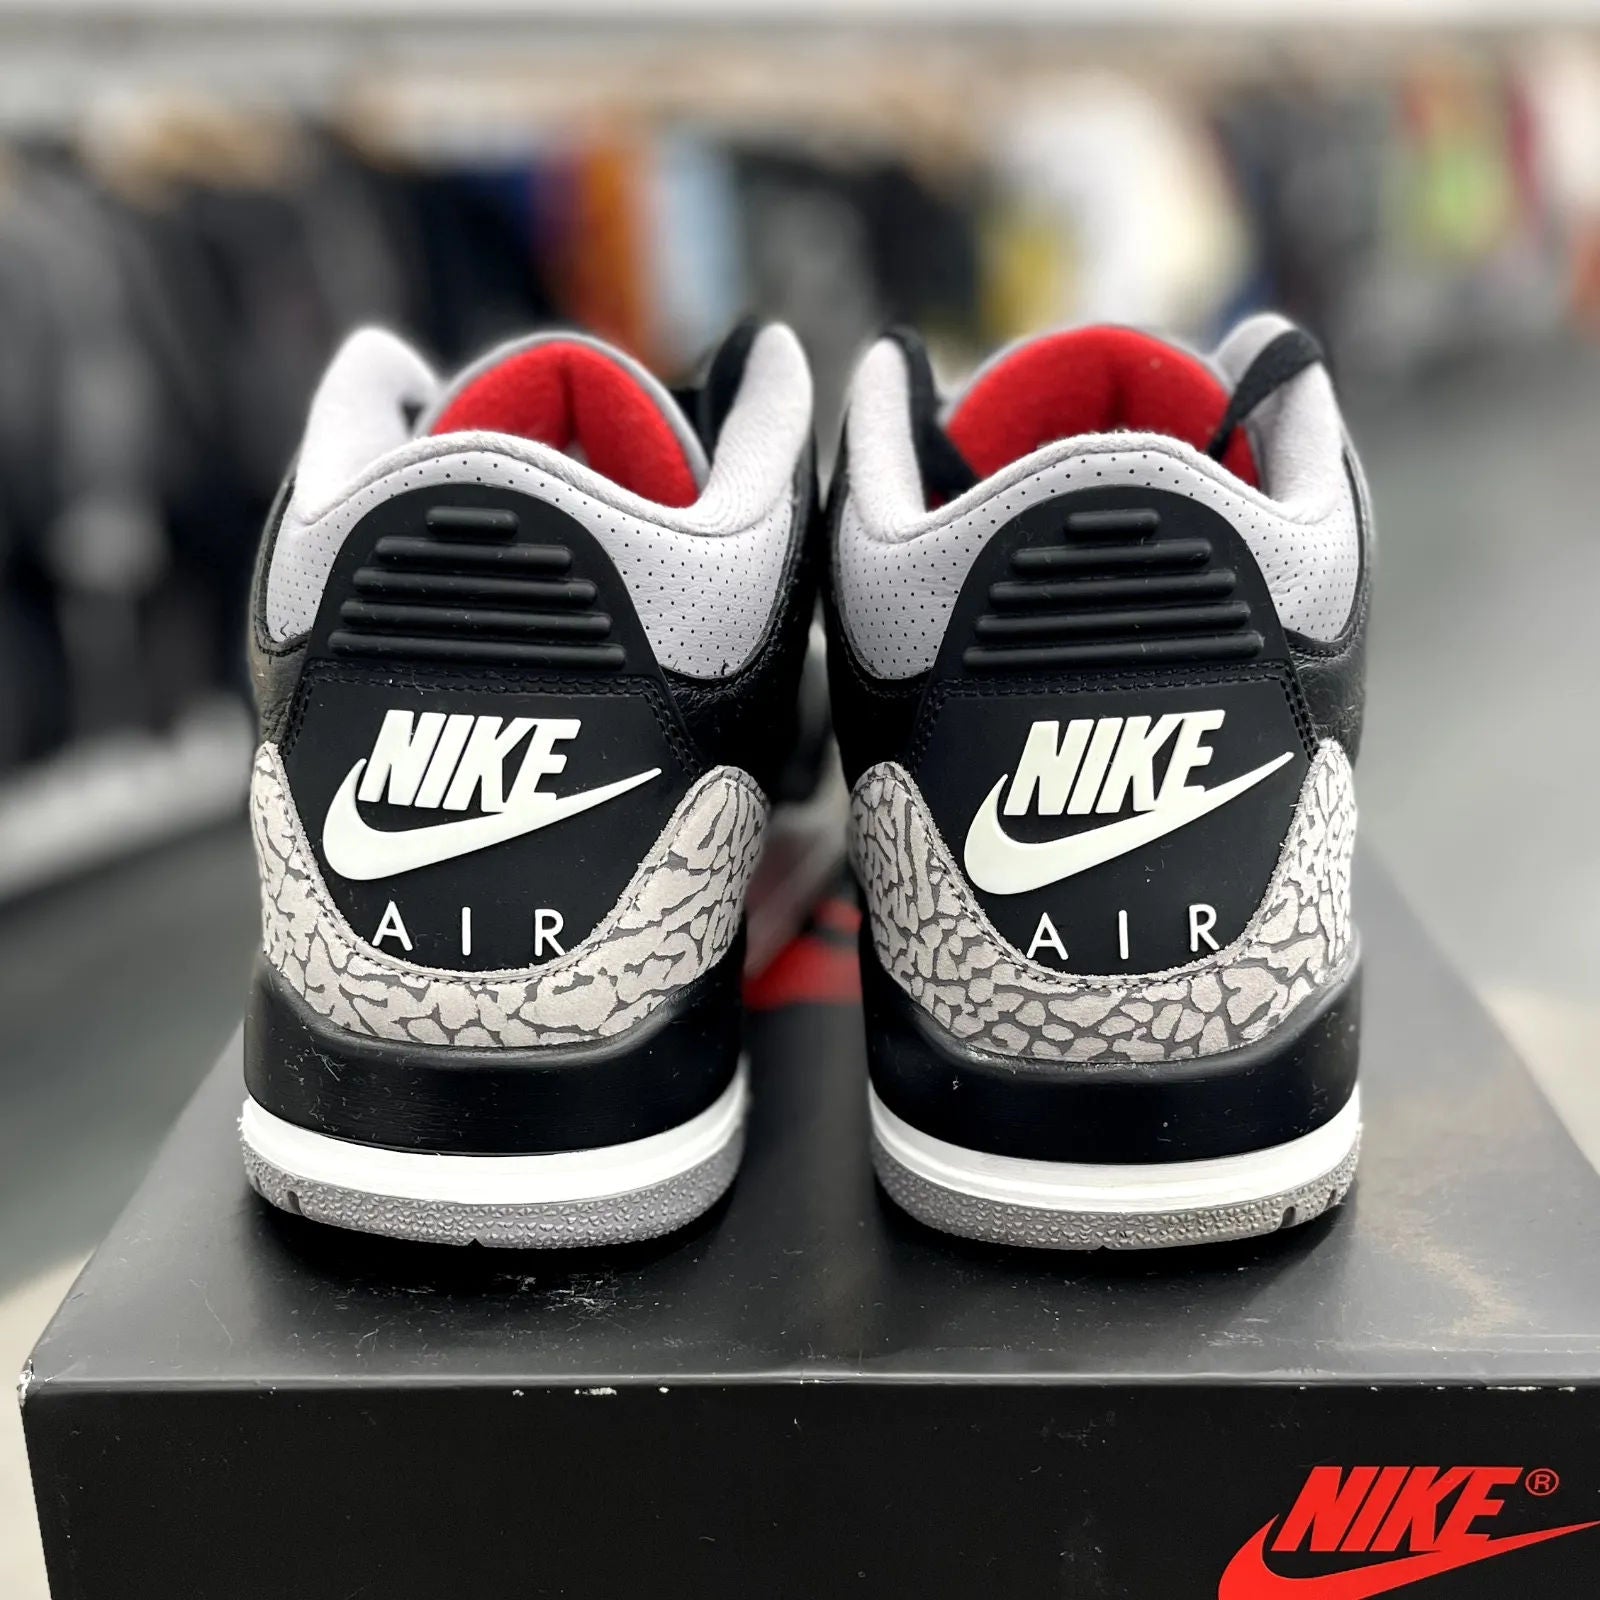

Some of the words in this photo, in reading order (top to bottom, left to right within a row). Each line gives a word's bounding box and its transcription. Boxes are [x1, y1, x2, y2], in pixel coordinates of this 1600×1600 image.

[358, 709, 582, 813] NIKE
[1003, 709, 1226, 816] NIKE
[371, 900, 566, 957] AIR
[1026, 903, 1220, 960] AIR
[1271, 1466, 1524, 1552] NIKE
